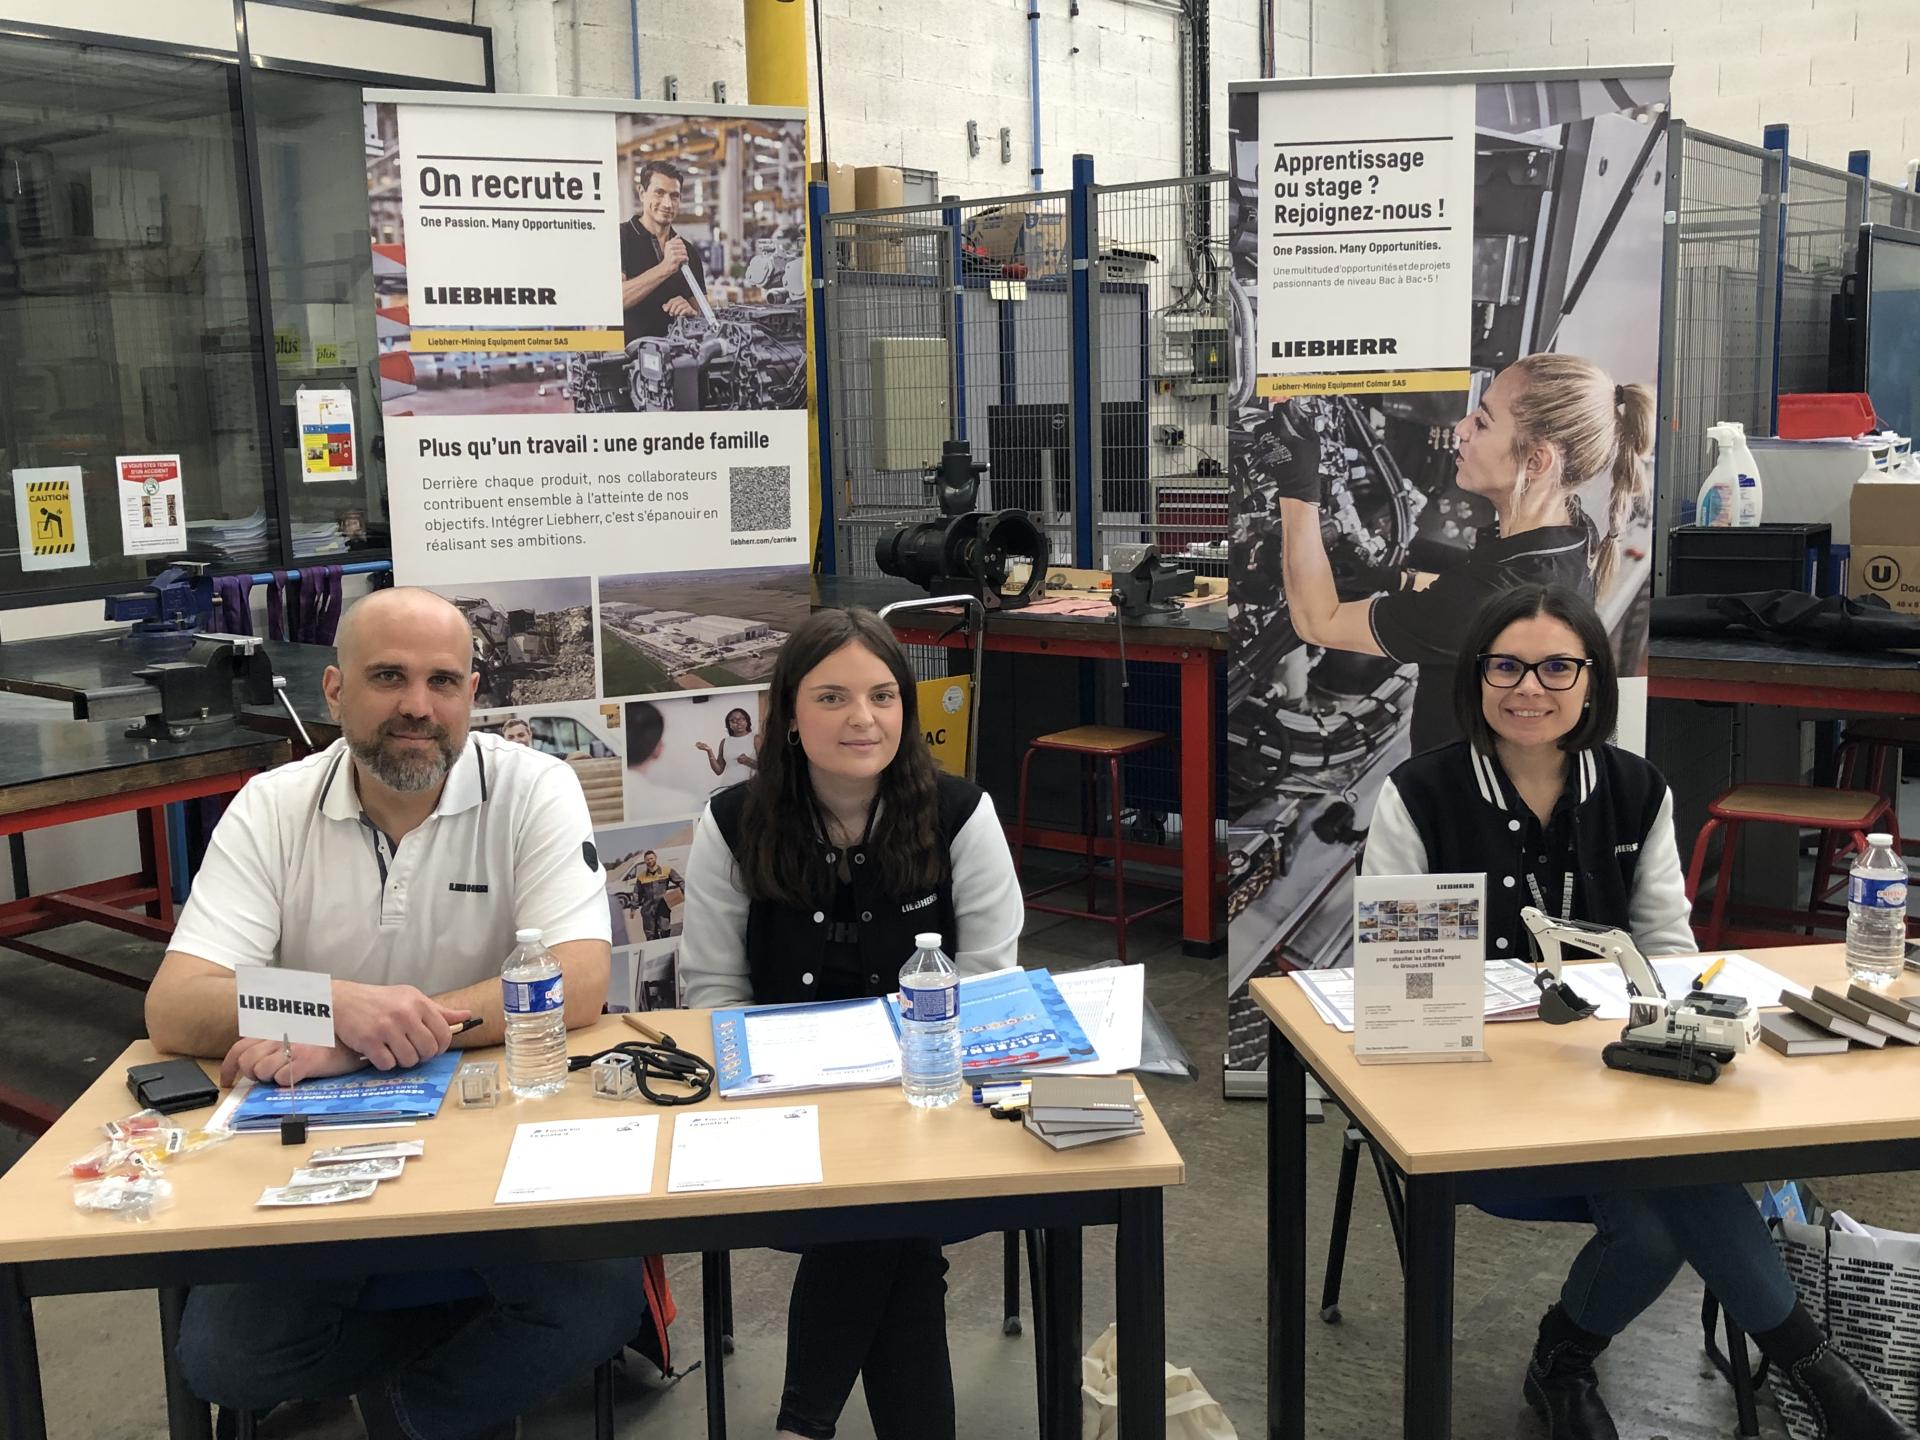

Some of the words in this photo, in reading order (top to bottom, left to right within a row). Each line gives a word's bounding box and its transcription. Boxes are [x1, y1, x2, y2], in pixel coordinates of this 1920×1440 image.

[1273, 149, 1425, 176] Apprentissage
[419, 166, 461, 198] On
[471, 171, 583, 201] recrute
[593, 172, 601, 201] !
[1274, 181, 1299, 199] ou
[1304, 177, 1362, 200] stage
[1368, 174, 1380, 195] ?
[1274, 201, 1432, 228] Rejoignez-nous
[1438, 198, 1445, 218] !
[420, 216, 442, 228] One
[444, 216, 490, 229] Passion.
[492, 217, 519, 231] Many
[522, 218, 596, 231] Opportunities.
[1273, 245, 1293, 257] One
[1295, 243, 1337, 255] Passion.
[1339, 243, 1367, 256] Many
[1369, 240, 1441, 255] Opportunities.
[1273, 266, 1290, 276] Une
[1273, 278, 1332, 290] passionnants
[1334, 277, 1345, 286] de
[1347, 276, 1377, 286] niveau
[1379, 275, 1395, 285] Bac
[424, 286, 557, 305] LIEBHERR
[428, 337, 486, 347] Liebherr-Mining
[487, 338, 526, 347] Equipment
[527, 337, 552, 346] Colmar
[554, 338, 569, 346] SAS
[1272, 337, 1398, 358] LIEBHERR
[316, 348, 336, 363] plus
[1272, 381, 1326, 391] Liebherr-Mining
[1327, 380, 1365, 390] Equipment
[1366, 379, 1390, 388] Colmar
[1392, 379, 1406, 387] SAS
[419, 438, 463, 457] Plus
[467, 437, 522, 460] qu’un
[527, 434, 588, 454] travail
[593, 438, 599, 453] :
[604, 437, 638, 452] une
[642, 432, 705, 455] grande
[710, 430, 770, 450] famille
[422, 476, 478, 490] Derrière
[484, 475, 535, 490] chaque
[541, 472, 592, 488] produit,
[598, 472, 621, 484] nos
[627, 469, 718, 483] collaborateurs
[29, 494, 69, 503] CAUTION
[423, 496, 504, 511] contribuent
[507, 493, 572, 508] ensemble
[575, 492, 584, 505] à
[587, 490, 644, 505] l'atteinte
[647, 489, 663, 502] de
[666, 490, 689, 501] nos
[425, 516, 489, 533] objectifs.
[491, 515, 544, 530] Intégrer
[546, 512, 603, 527] Liebherr,
[605, 511, 635, 524] c'est
[637, 508, 702, 525] s'épanouir
[703, 508, 718, 520] en
[426, 537, 487, 552] réalisant
[490, 538, 514, 549] ses
[517, 533, 587, 548] ambitions.
[921, 729, 946, 746] AC
[239, 994, 331, 1018] LIEBHERR
